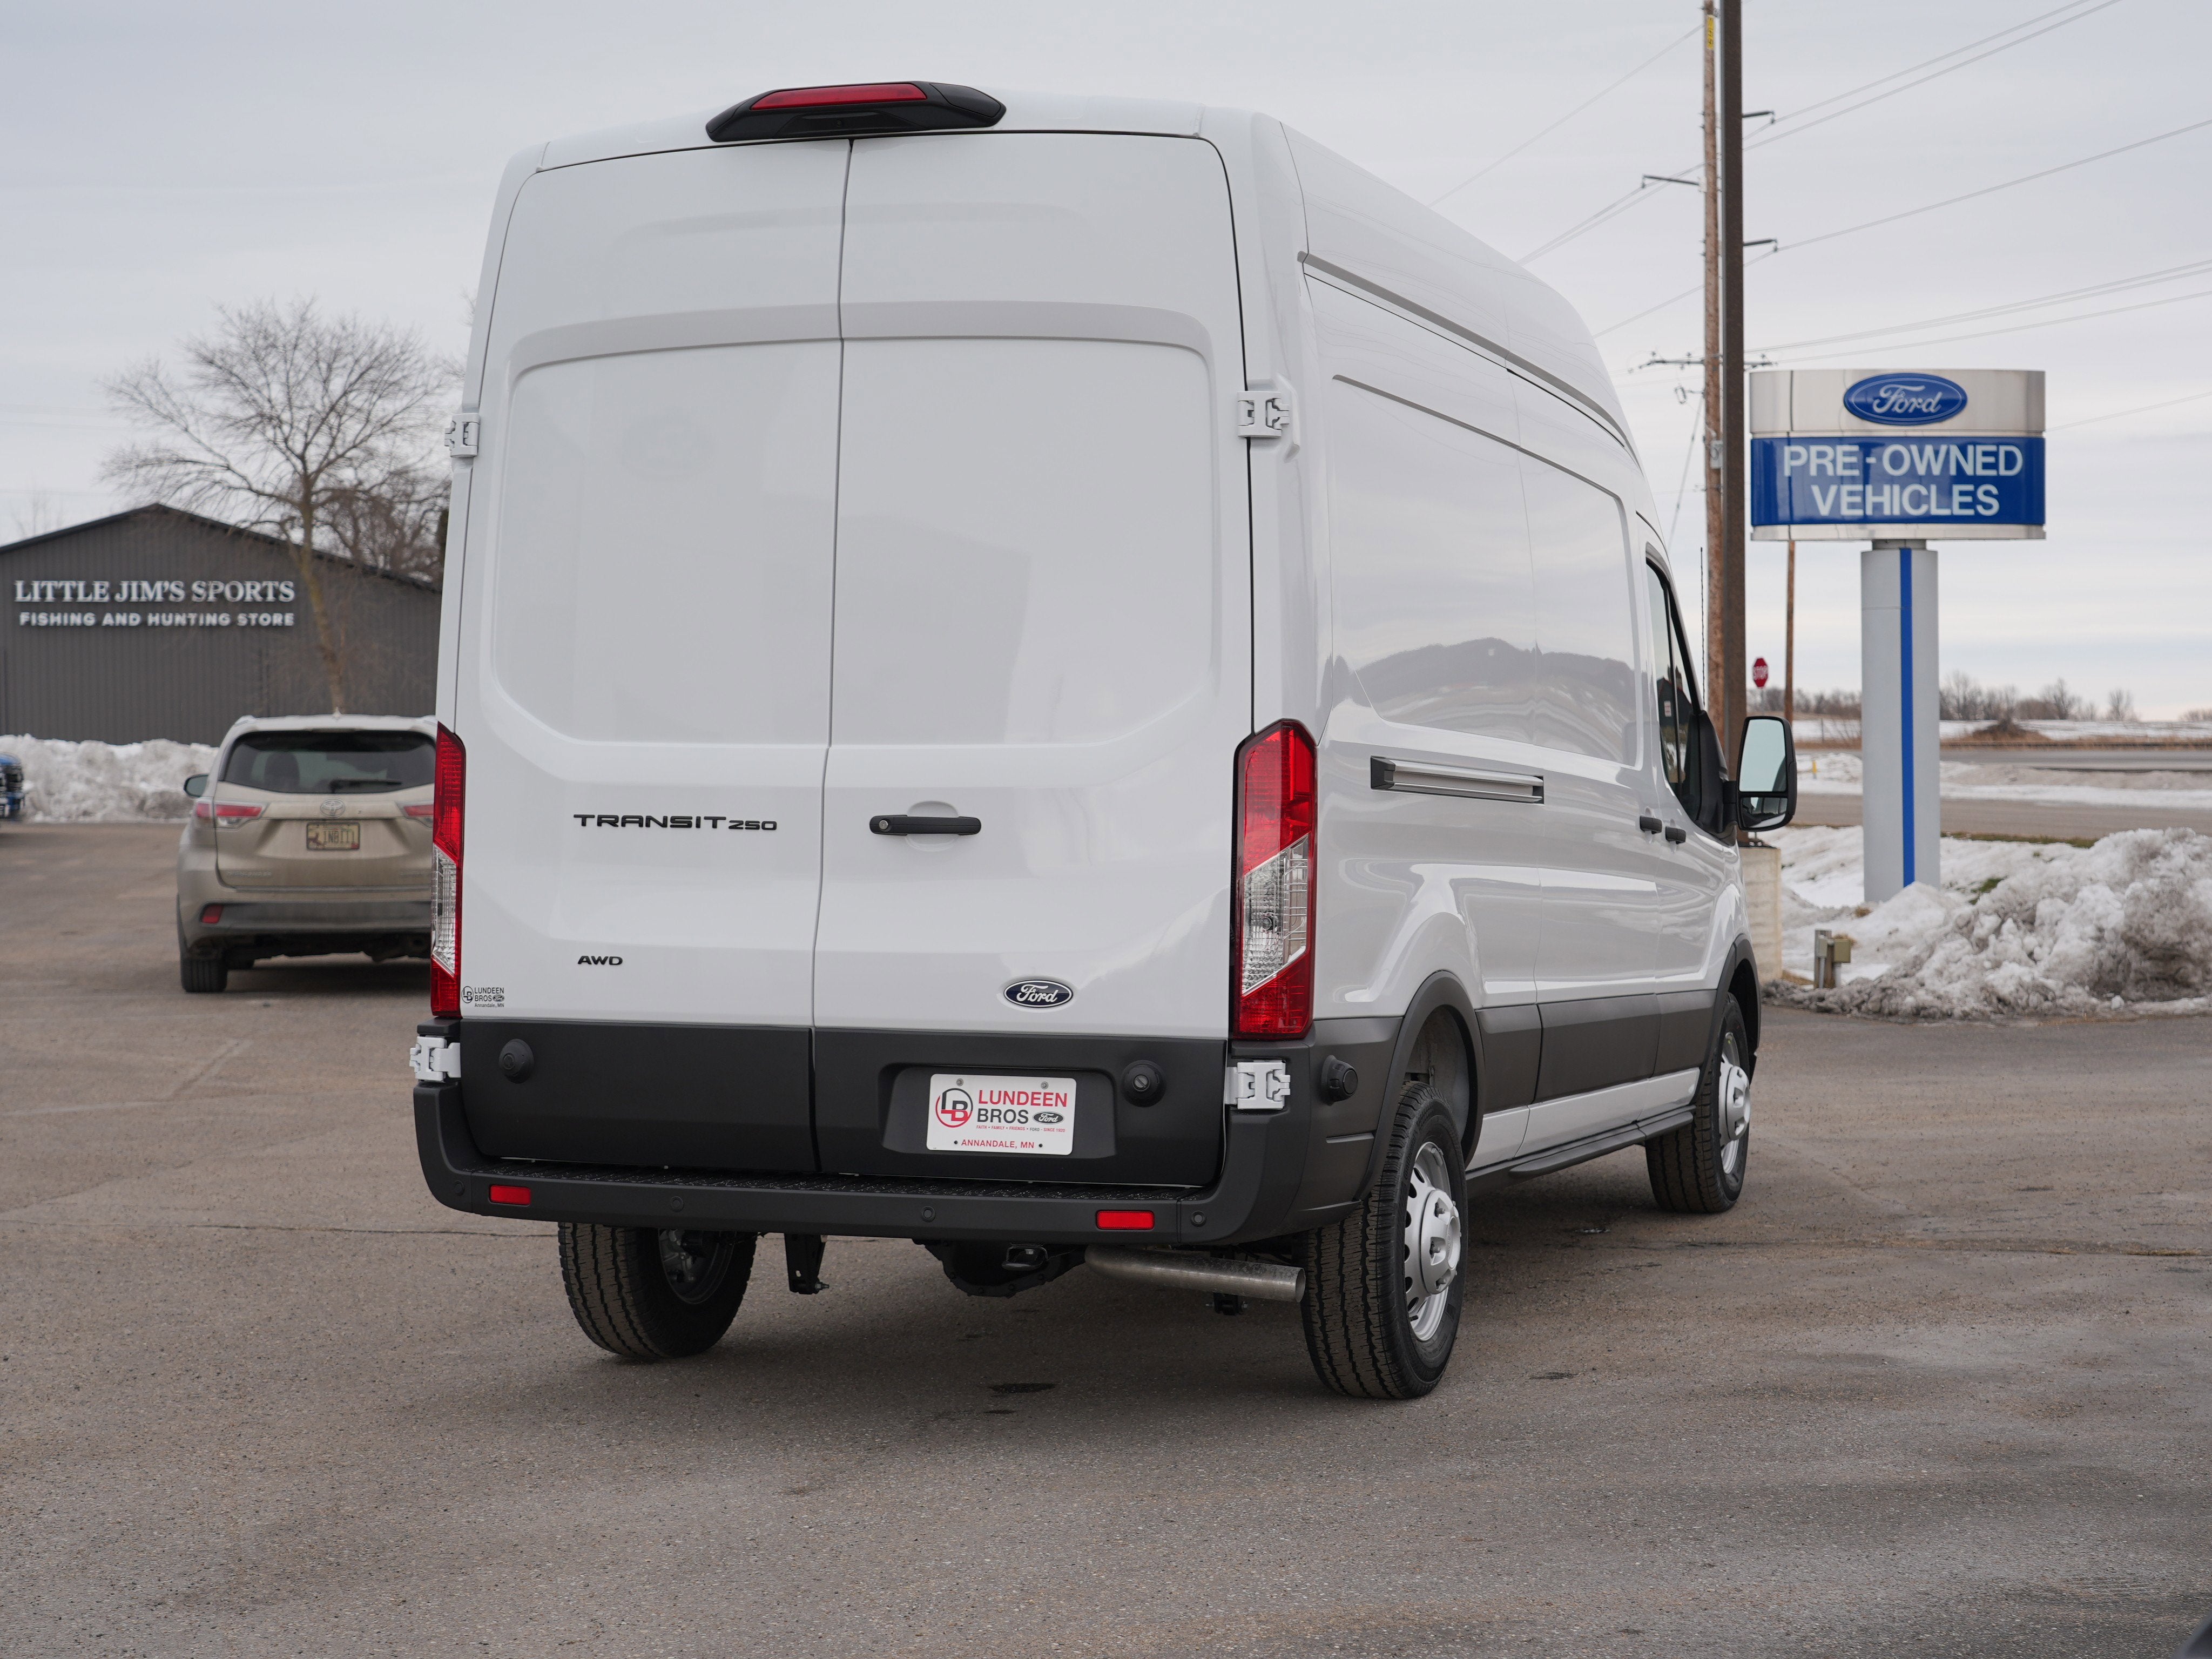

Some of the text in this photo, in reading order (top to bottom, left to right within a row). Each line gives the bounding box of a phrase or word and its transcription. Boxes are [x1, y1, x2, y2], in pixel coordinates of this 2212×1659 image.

[1872, 383, 1943, 414] Ford
[1783, 444, 2024, 477] PRE-OWNED
[1810, 483, 1999, 516] VEHICLES
[15, 580, 295, 603] LITTLE JIM'S SPORTS
[19, 612, 295, 626] FISHING AND HUNTING STORE
[574, 814, 777, 831] TRANSIT 250
[577, 955, 623, 966] AWD
[1016, 984, 1058, 1003] Ford
[978, 1089, 1068, 1108] LUNDEEN
[977, 1108, 1060, 1124] BROS Ford
[961, 1139, 1017, 1149] ANNANDALE,
